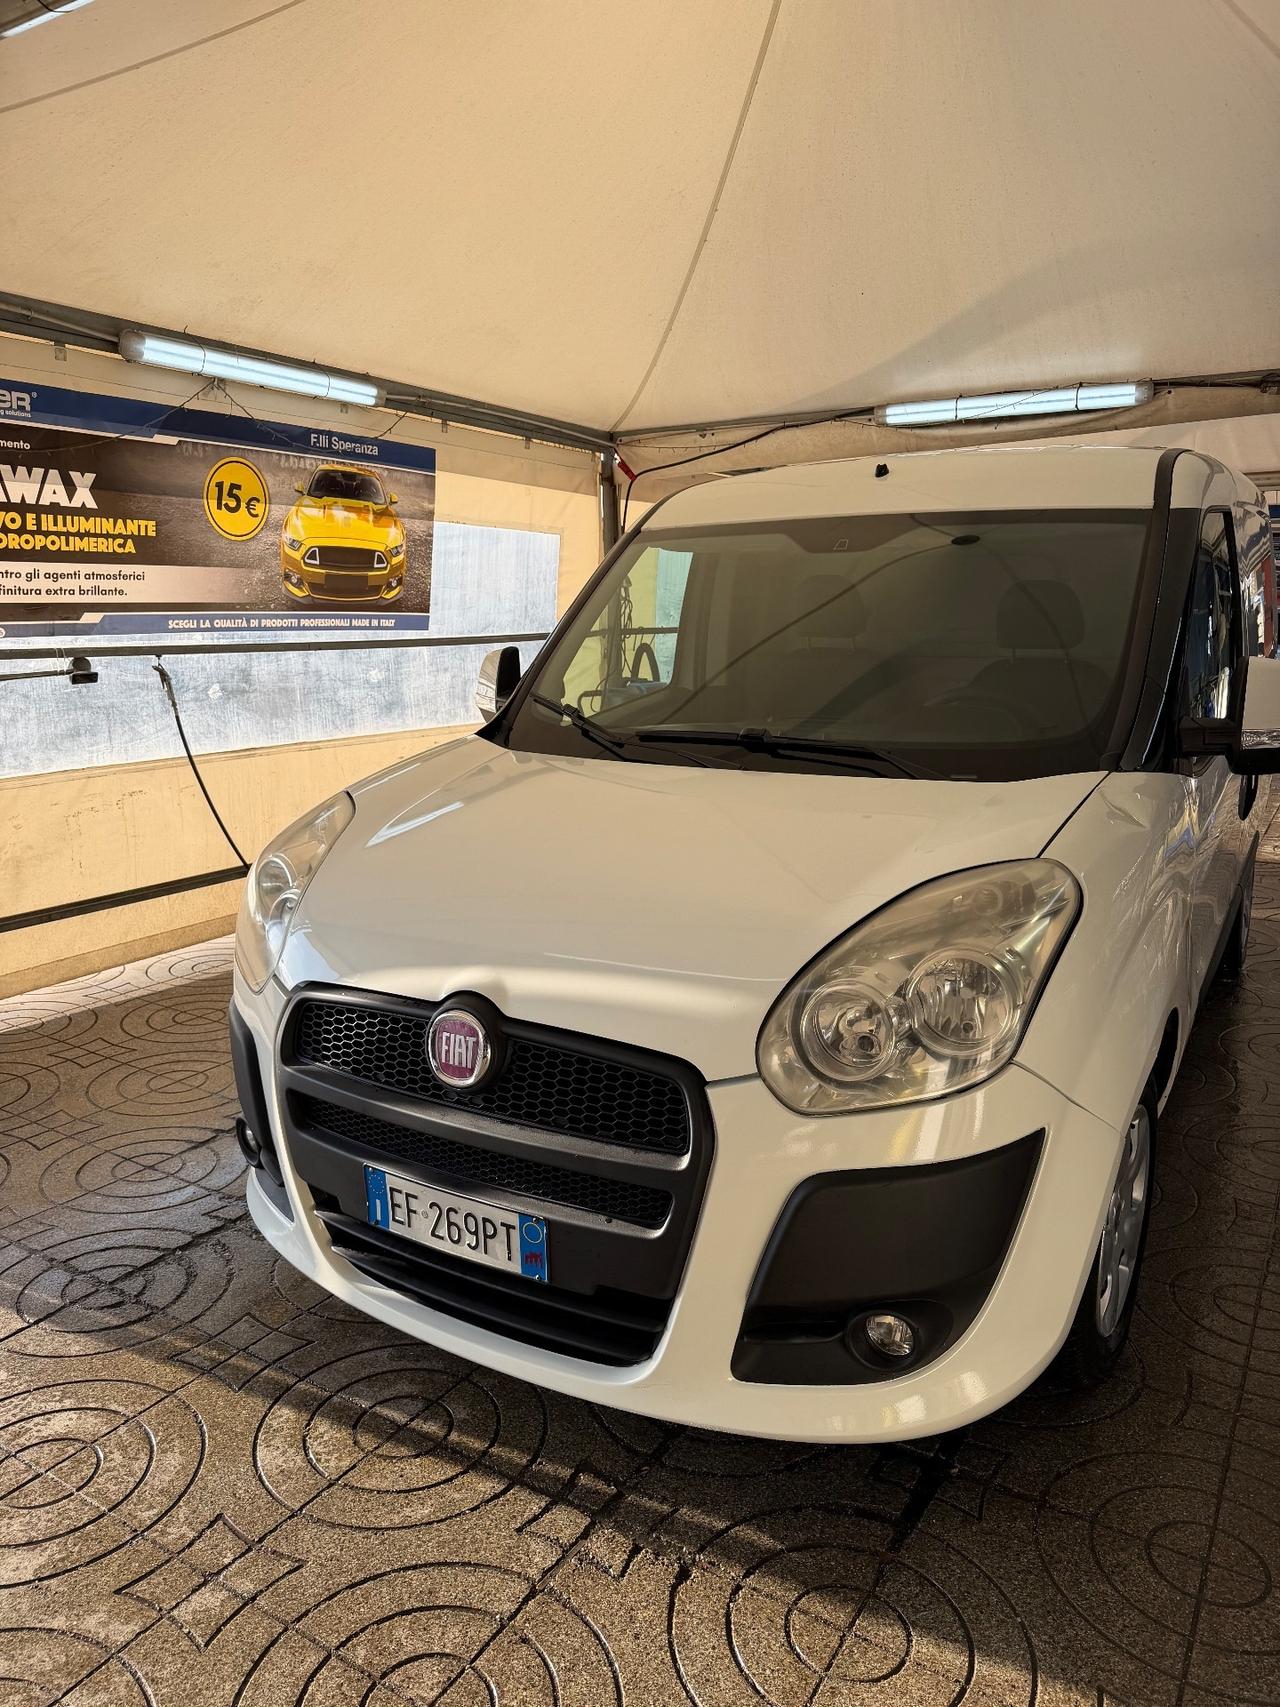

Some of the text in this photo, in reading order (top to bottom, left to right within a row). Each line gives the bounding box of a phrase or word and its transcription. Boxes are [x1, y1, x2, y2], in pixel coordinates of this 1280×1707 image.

[331, 436, 379, 456] Speranza
[26, 512, 37, 531] E
[41, 514, 157, 537] ILLUMINANTE
[25, 568, 40, 582] gli
[44, 570, 81, 582] agenti
[84, 570, 145, 581] atmosferici
[45, 586, 75, 596] extra
[79, 585, 128, 596] brillante.
[168, 617, 396, 629] SCEGLI LA QUALITÀ DI PRODOTTI PROFESSIONALI MADE IN ITALY
[441, 1031, 476, 1069] FIAT
